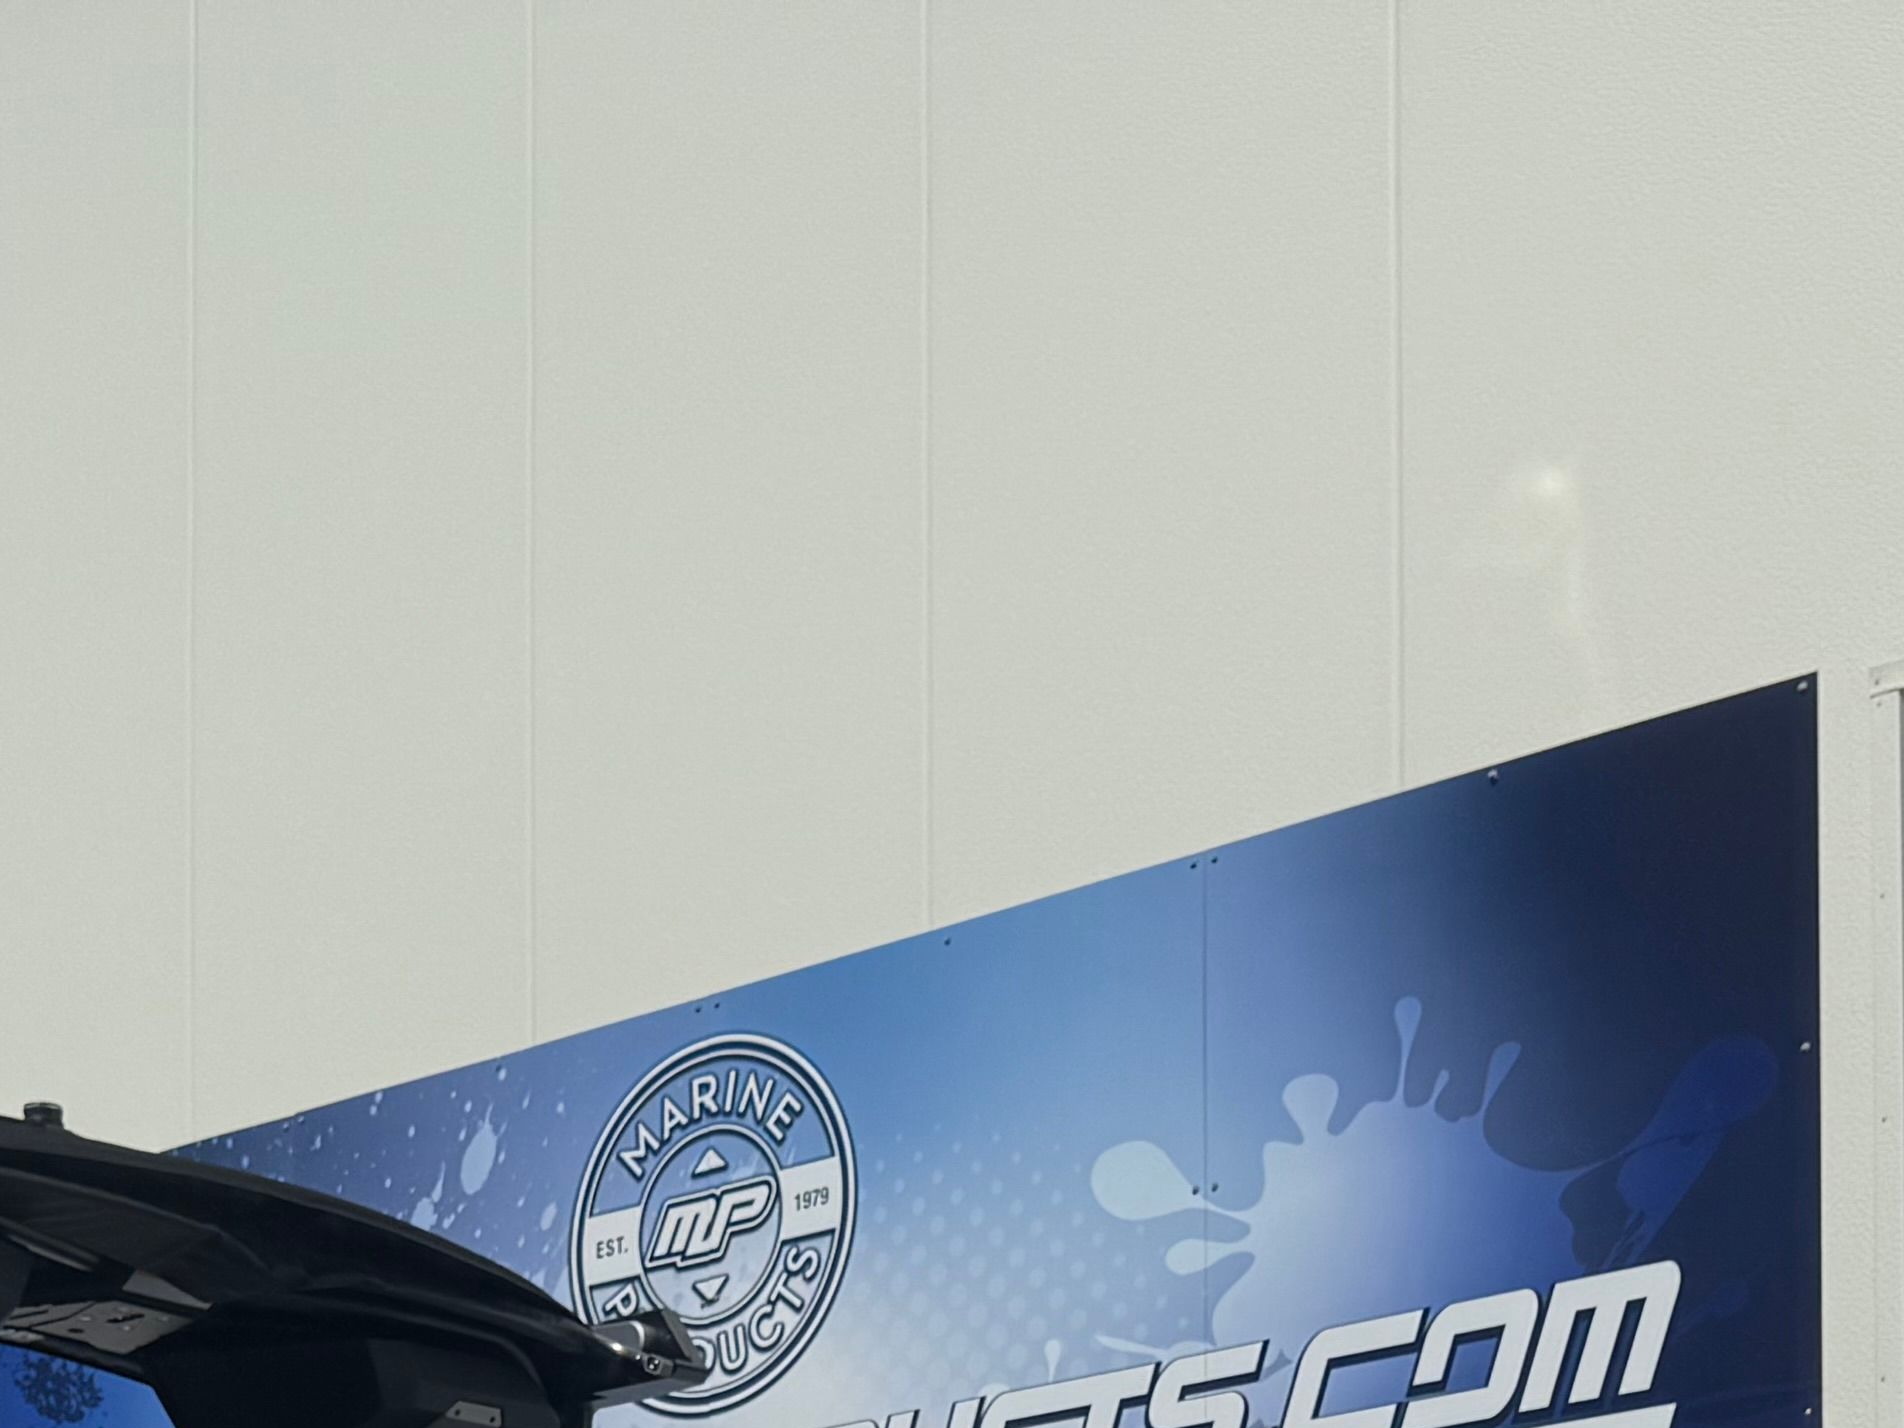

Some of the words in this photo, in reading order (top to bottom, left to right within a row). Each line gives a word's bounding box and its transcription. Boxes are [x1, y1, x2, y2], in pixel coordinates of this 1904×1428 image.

[617, 1069, 803, 1178] MARINE
[596, 1235, 629, 1259] EST.
[794, 1187, 830, 1211] 1979
[604, 1244, 820, 1373] PDUCTS
